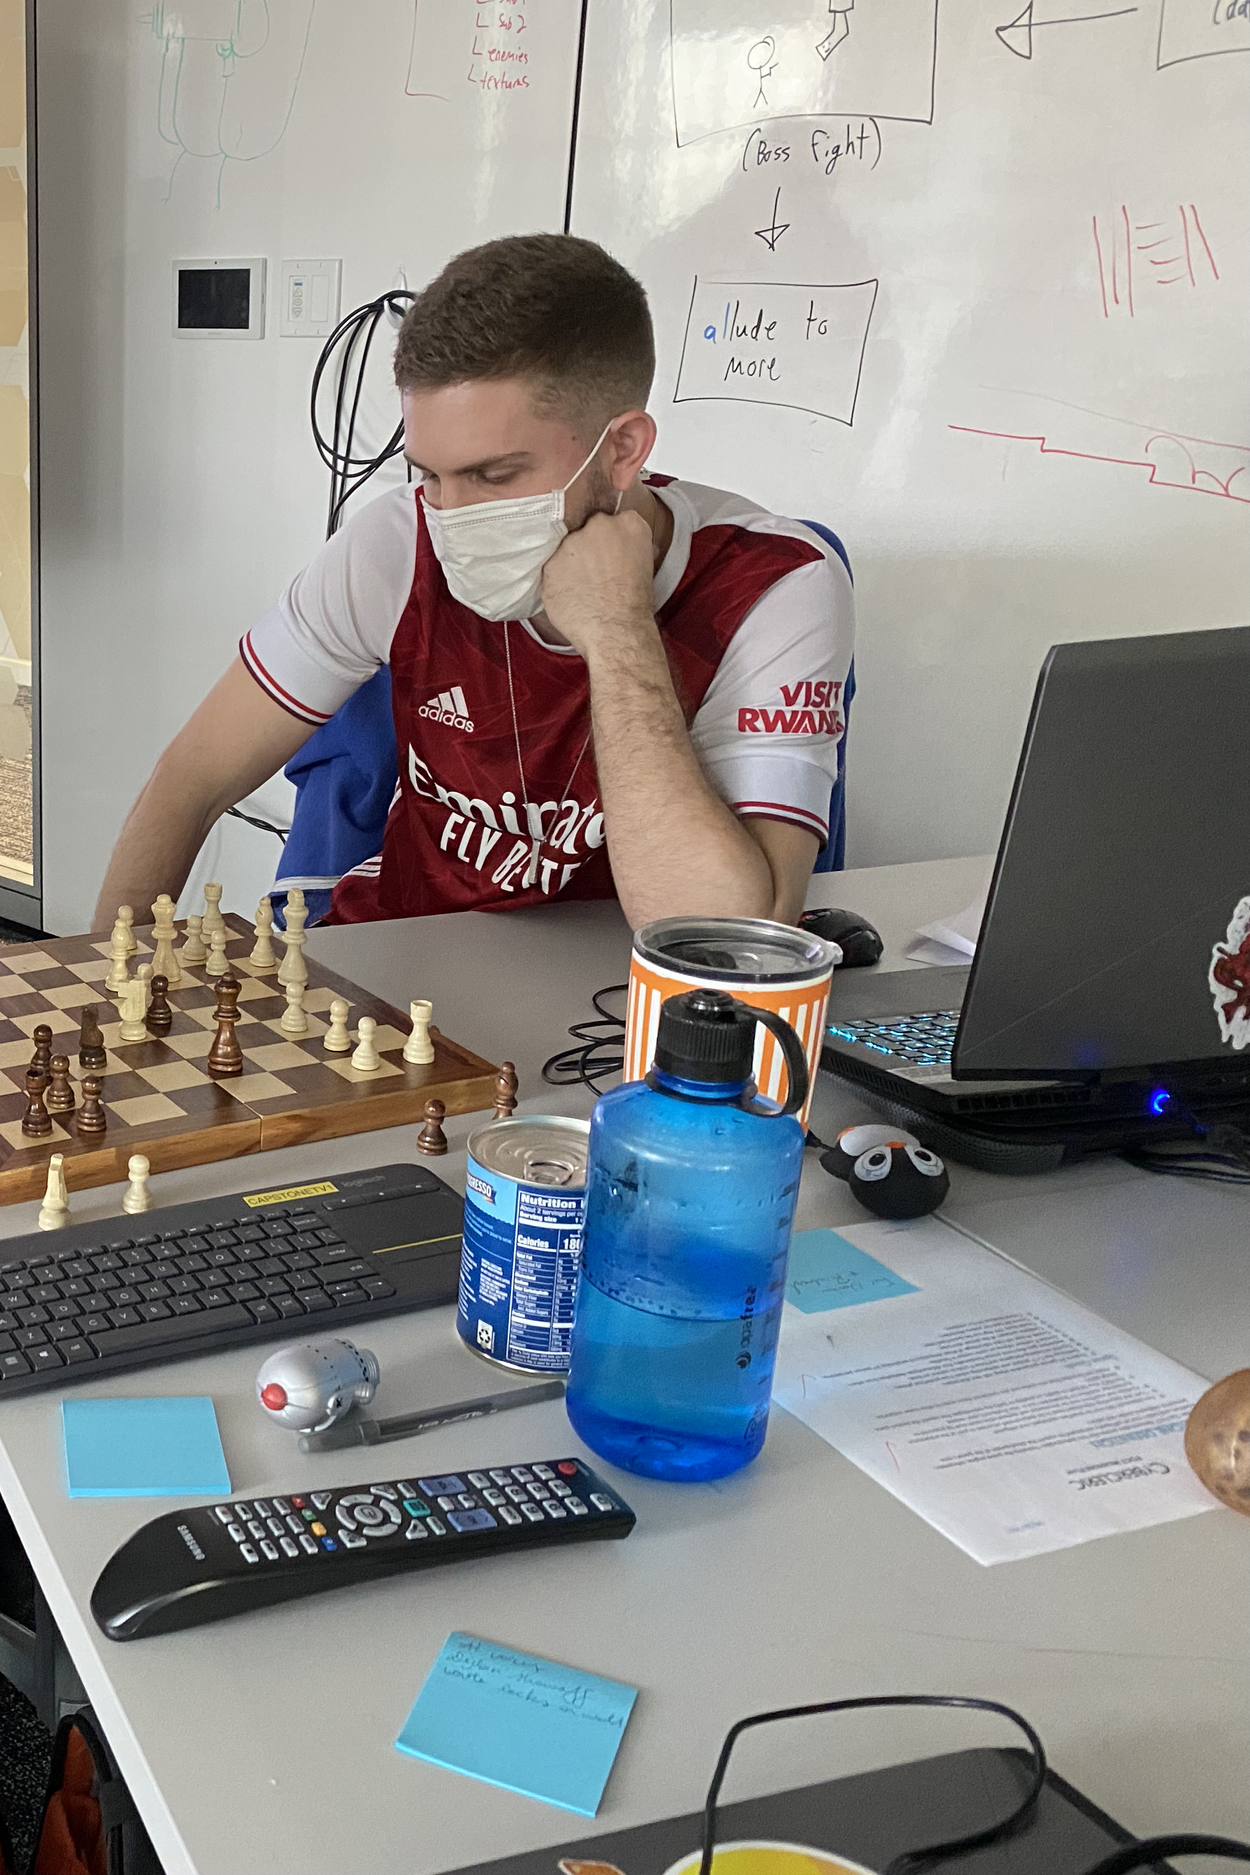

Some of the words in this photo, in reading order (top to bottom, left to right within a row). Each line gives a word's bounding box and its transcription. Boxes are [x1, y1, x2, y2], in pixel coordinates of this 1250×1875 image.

[488, 46, 528, 64] enemies
[704, 300, 777, 344] allude
[806, 300, 828, 340] to
[724, 356, 781, 381] more
[779, 681, 843, 708] VISIT
[418, 705, 474, 733] adidas
[737, 707, 844, 735] RWAN
[408, 742, 607, 855] Emirate
[440, 812, 502, 871] FLY
[248, 1184, 334, 1205] CAPSTONETV1
[521, 1193, 576, 1209] Nutrition
[519, 1211, 542, 1222] Serving
[543, 1215, 557, 1223] size
[542, 1209, 566, 1218] servings
[517, 1234, 549, 1249] Calories
[177, 1524, 206, 1561] SAMSUNG
